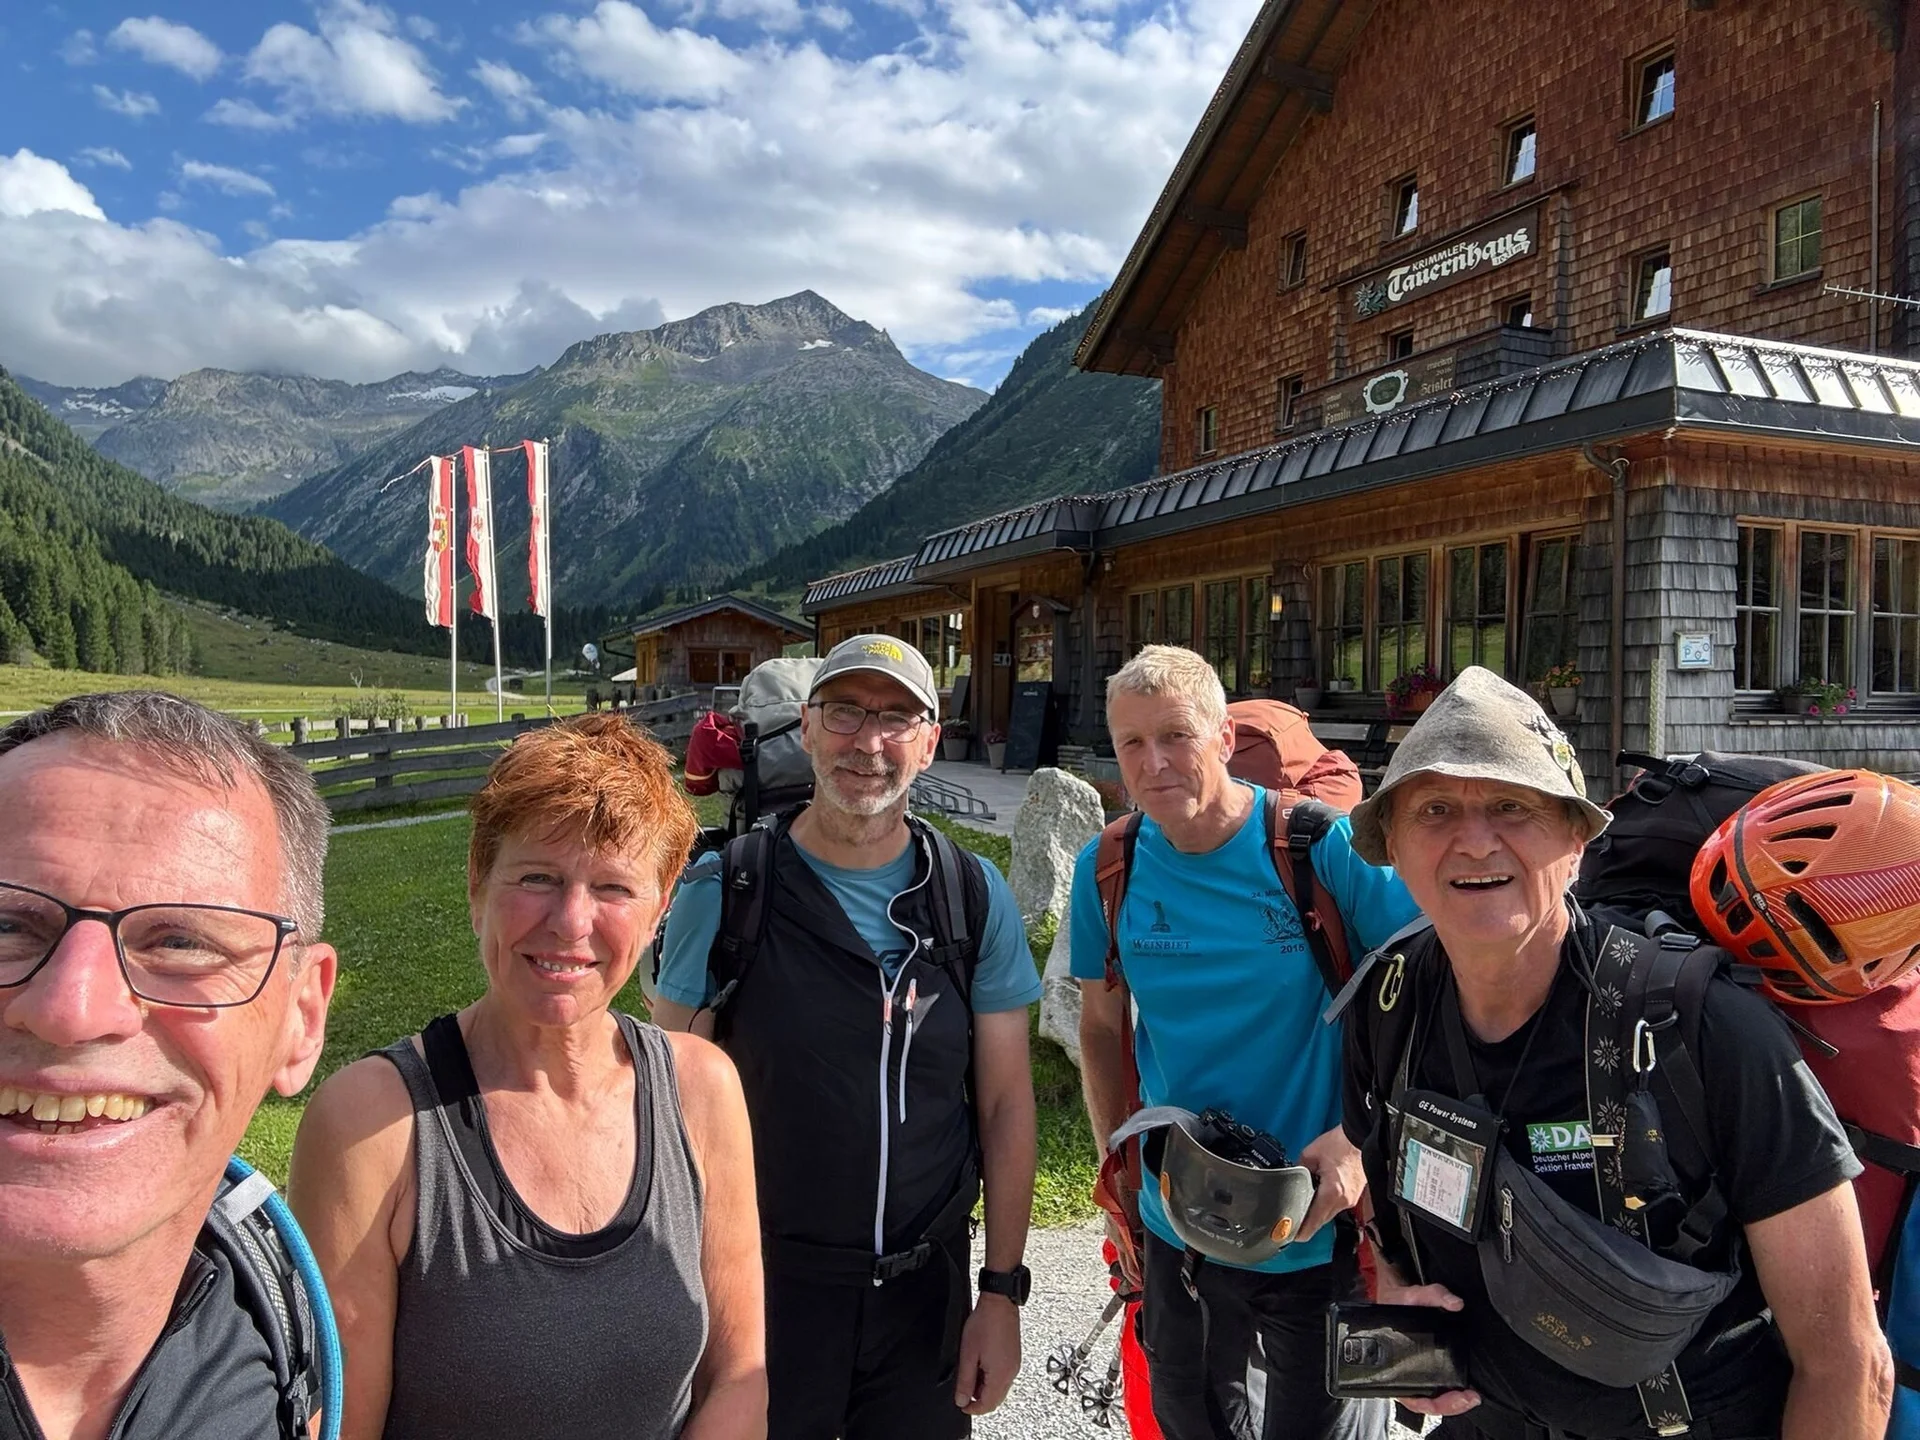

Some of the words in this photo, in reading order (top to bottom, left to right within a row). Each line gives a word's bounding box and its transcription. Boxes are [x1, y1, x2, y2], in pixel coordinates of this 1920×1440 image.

[1387, 227, 1528, 302] Tauernhaus
[1412, 241, 1467, 272] KRIMMLER
[1132, 939, 1191, 950] WEINBIET
[1418, 1100, 1430, 1110] GE
[1428, 1104, 1450, 1118] Power
[1450, 1112, 1478, 1129] Systems
[1551, 1124, 1591, 1148] DA
[1532, 1153, 1570, 1163] Deutscher
[1534, 1163, 1563, 1173] Sektion
